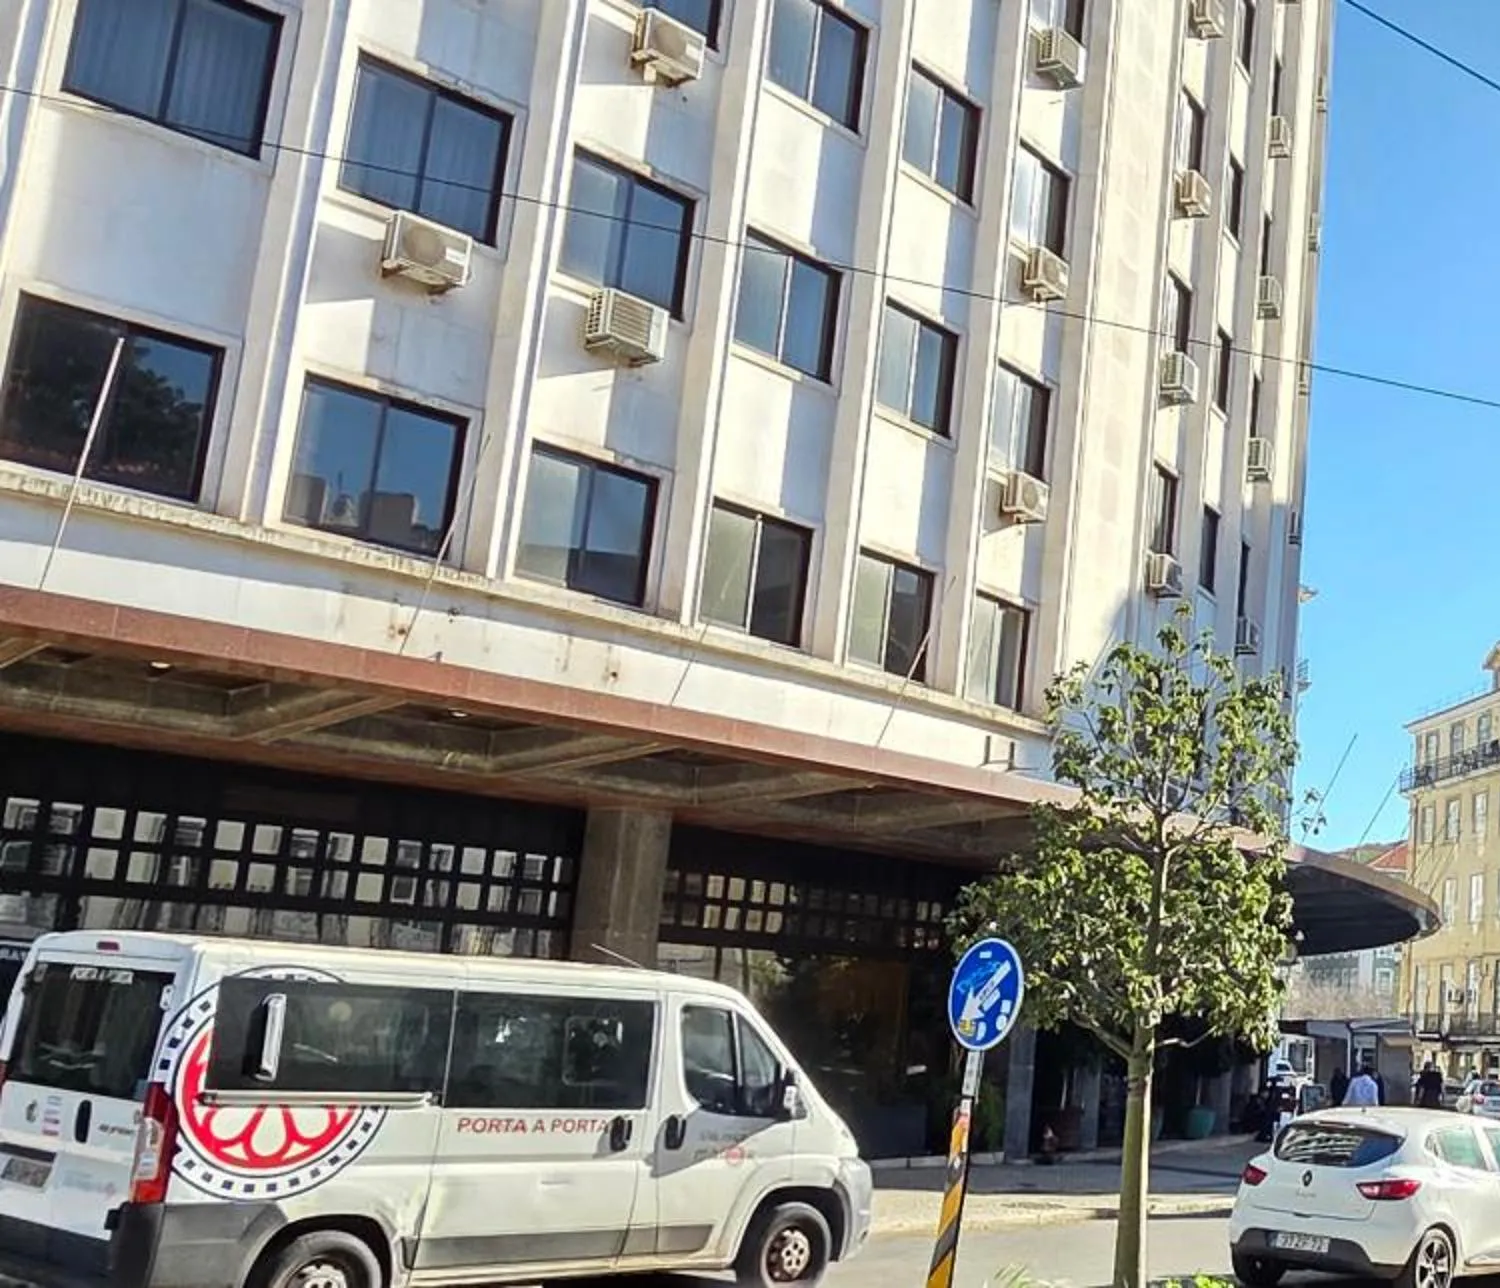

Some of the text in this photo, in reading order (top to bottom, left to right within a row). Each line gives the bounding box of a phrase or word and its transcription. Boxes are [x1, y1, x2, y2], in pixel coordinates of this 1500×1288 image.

[457, 1117, 609, 1135] PORTA A PORTA
